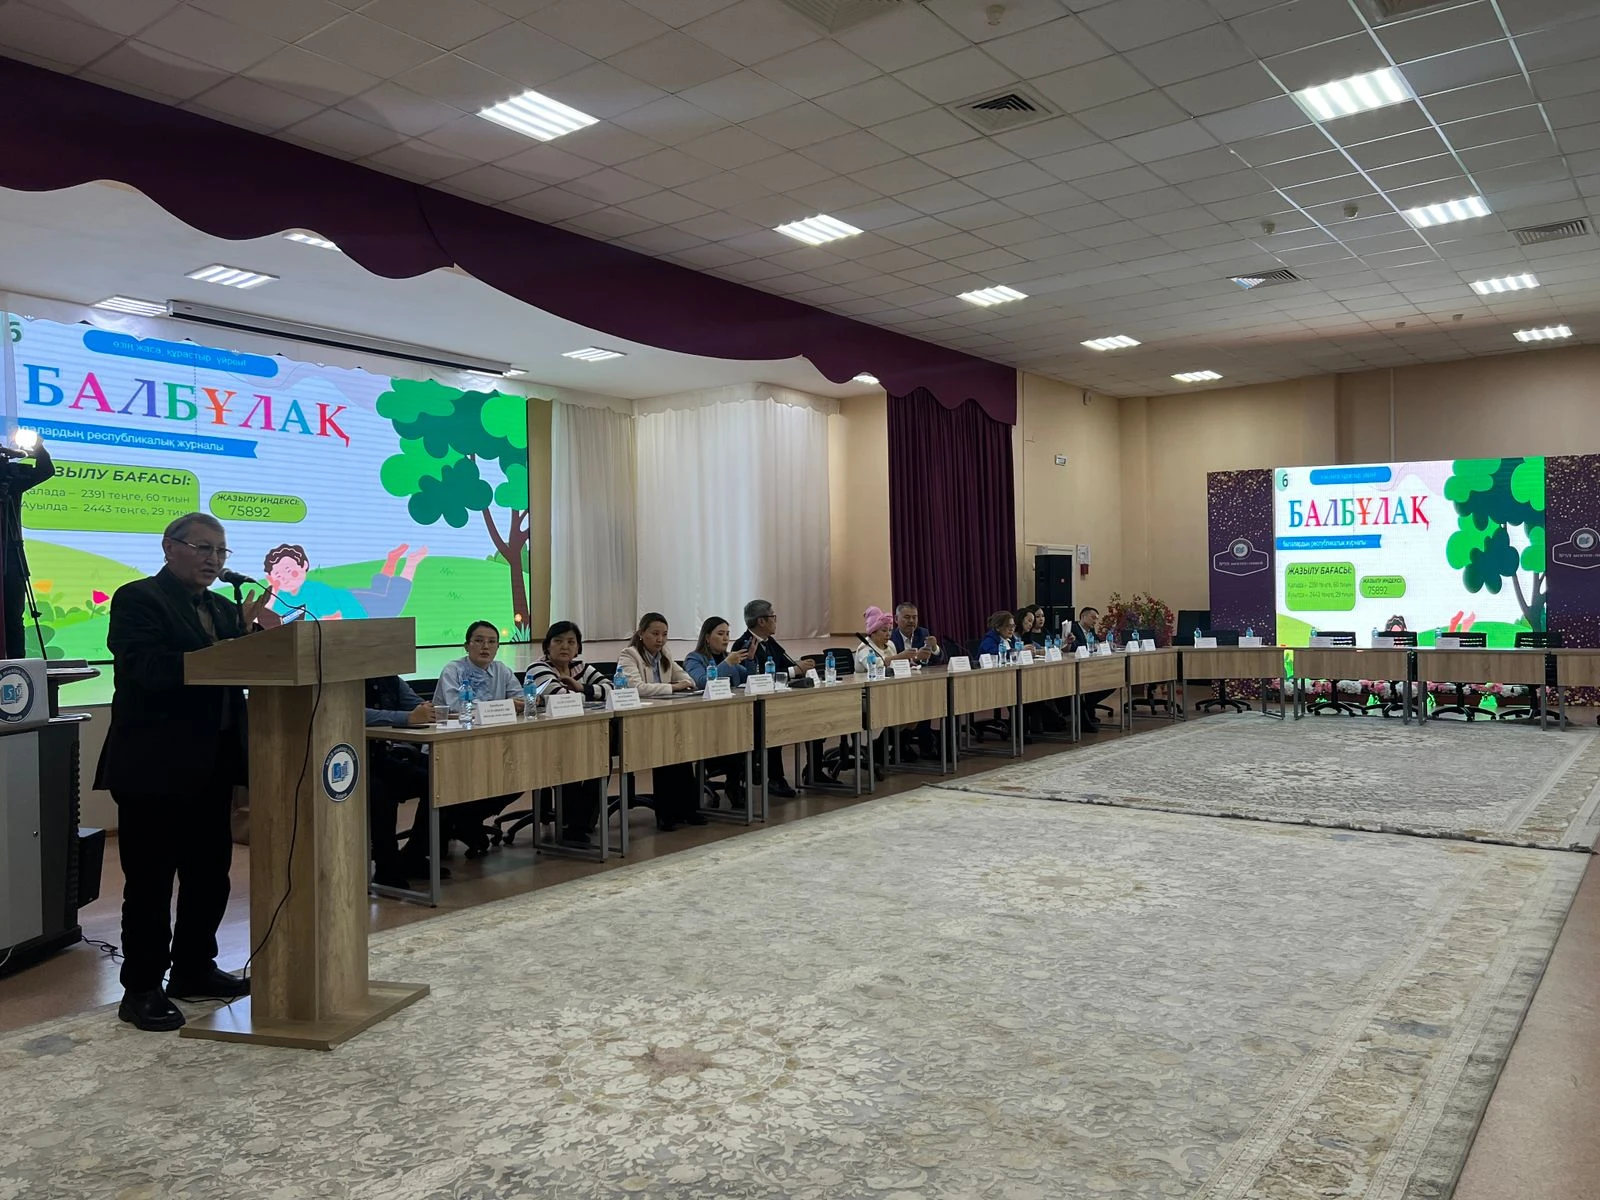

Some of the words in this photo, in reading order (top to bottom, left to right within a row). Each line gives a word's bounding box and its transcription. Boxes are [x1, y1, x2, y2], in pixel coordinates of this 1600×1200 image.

[23, 363, 350, 448] БАЛБҰЛАҚ
[87, 431, 175, 448] республикалық
[177, 439, 224, 451] журналы
[54, 466, 109, 480] ЗЫЛУ
[113, 470, 191, 486] БАҒАСЫ:
[1281, 473, 1289, 487] 6
[81, 489, 105, 499] 2391
[108, 492, 144, 503] теңге,
[146, 493, 160, 502] 60
[162, 495, 190, 503] тиын
[217, 494, 259, 503] ЖАЗЫЛУ
[21, 500, 68, 512] Ауылда
[83, 503, 112, 513] 2443
[115, 506, 149, 515] теңге,
[152, 507, 164, 516] 29
[228, 505, 271, 518] 75892
[1288, 495, 1430, 532] БАЛБҰЛАҚ
[1288, 567, 1320, 575] ЖАЗЫЛУ
[1368, 585, 1388, 595] 75892
